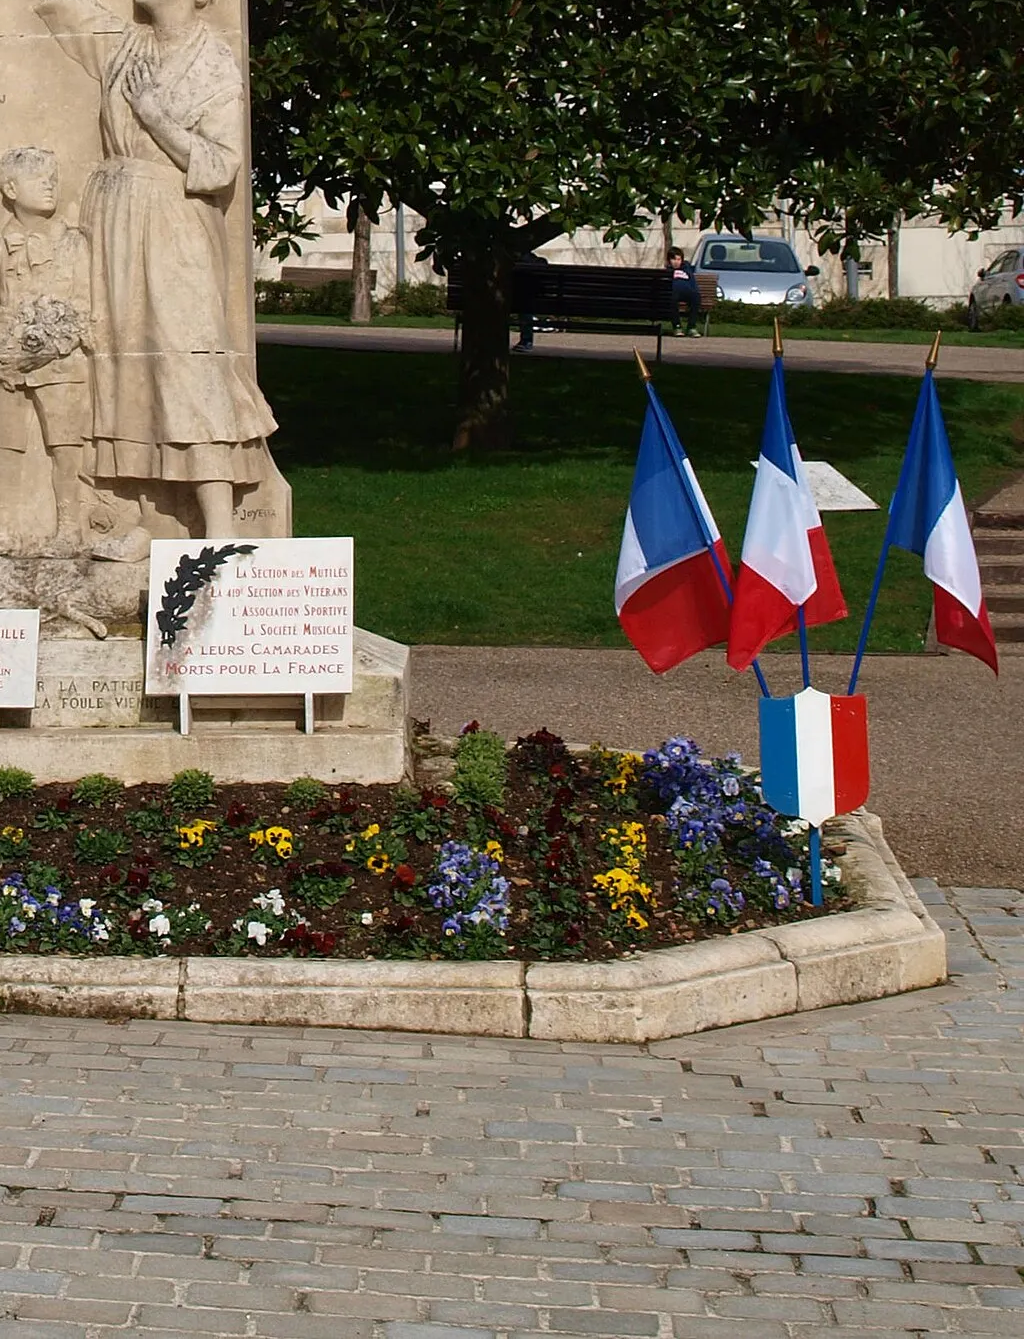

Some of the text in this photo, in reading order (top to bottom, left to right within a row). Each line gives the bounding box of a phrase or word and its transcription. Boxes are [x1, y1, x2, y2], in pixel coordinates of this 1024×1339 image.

[251, 567, 288, 578] SECTION
[247, 586, 283, 597] SECTION
[242, 604, 298, 616] ASSOCIATION
[304, 604, 348, 616] SPORTIVE
[201, 645, 244, 655] LEURS
[251, 643, 339, 655] CAMARADES
[165, 662, 344, 674] MORTS POUR LA FRANCE
[59, 680, 142, 693] LA PATRIE
[61, 698, 103, 709] FOULE
